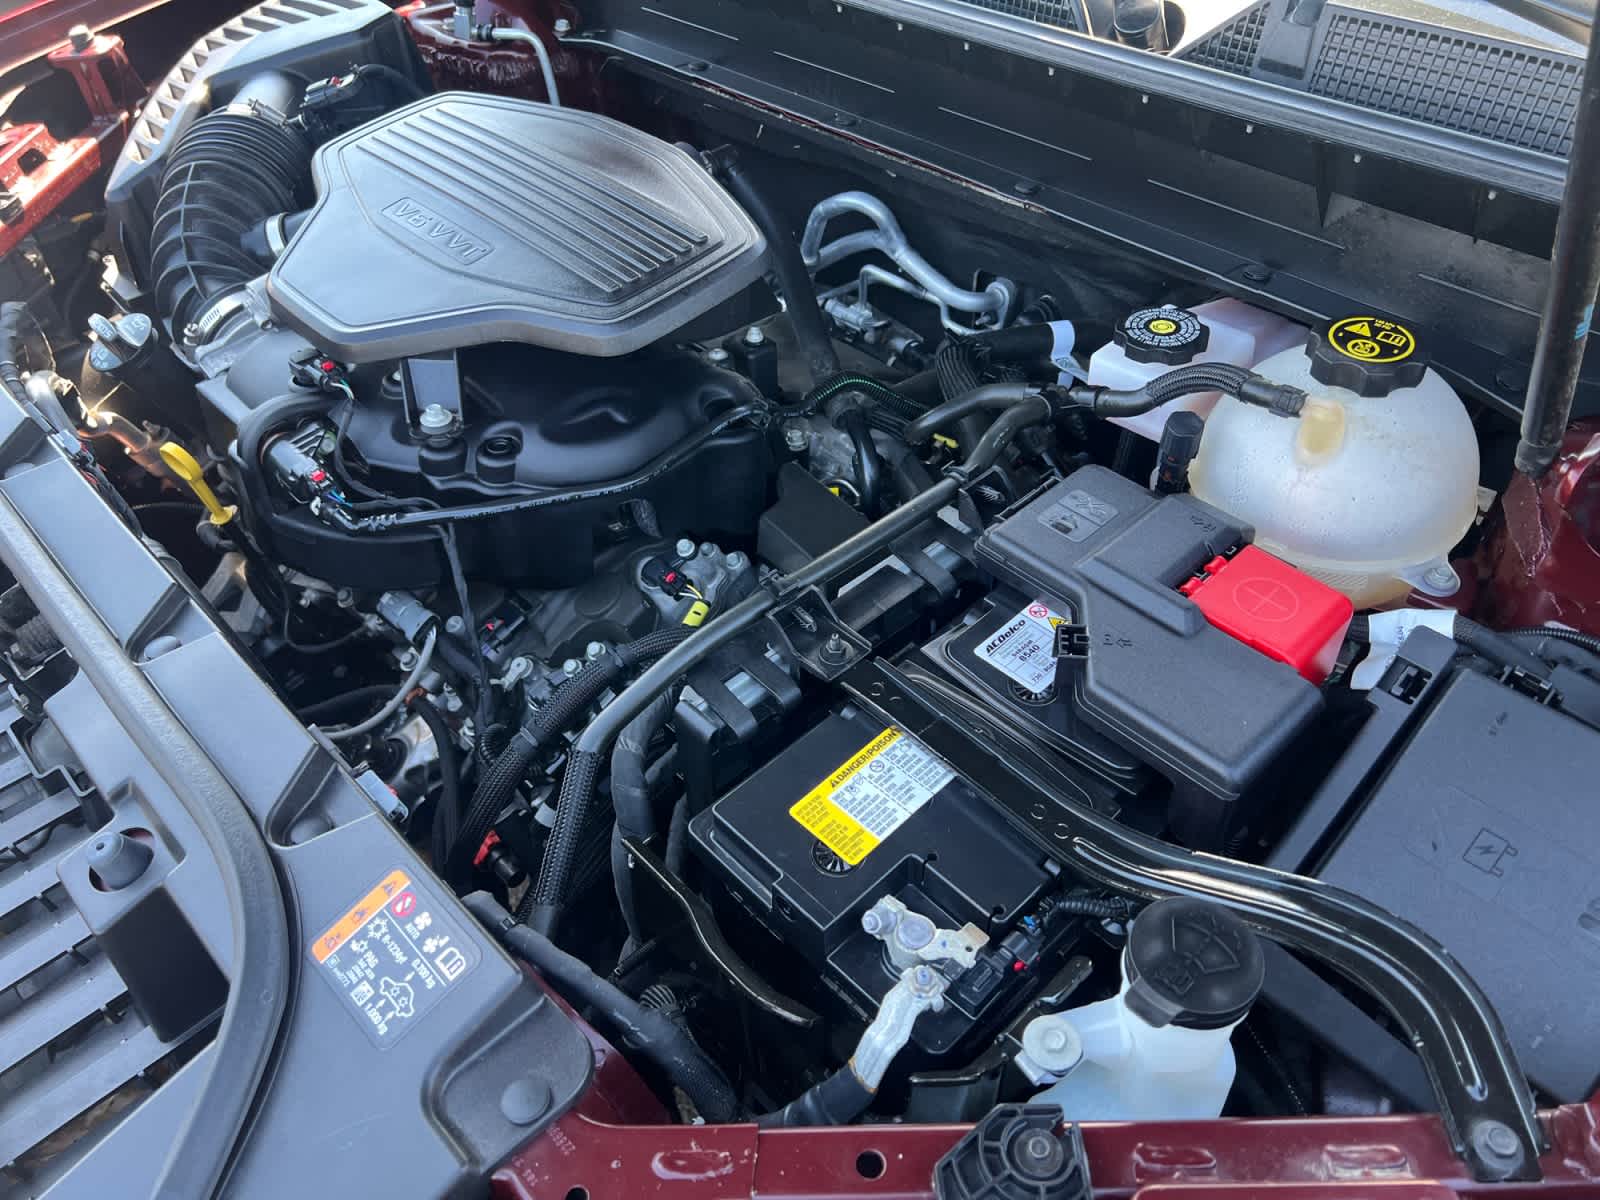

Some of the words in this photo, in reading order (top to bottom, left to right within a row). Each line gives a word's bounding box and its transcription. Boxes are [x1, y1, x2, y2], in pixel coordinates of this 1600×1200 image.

[394, 203, 433, 228] V6
[429, 222, 488, 258] VVT
[985, 619, 1026, 654] ACDelco
[836, 730, 898, 786] DANGER/POISON
